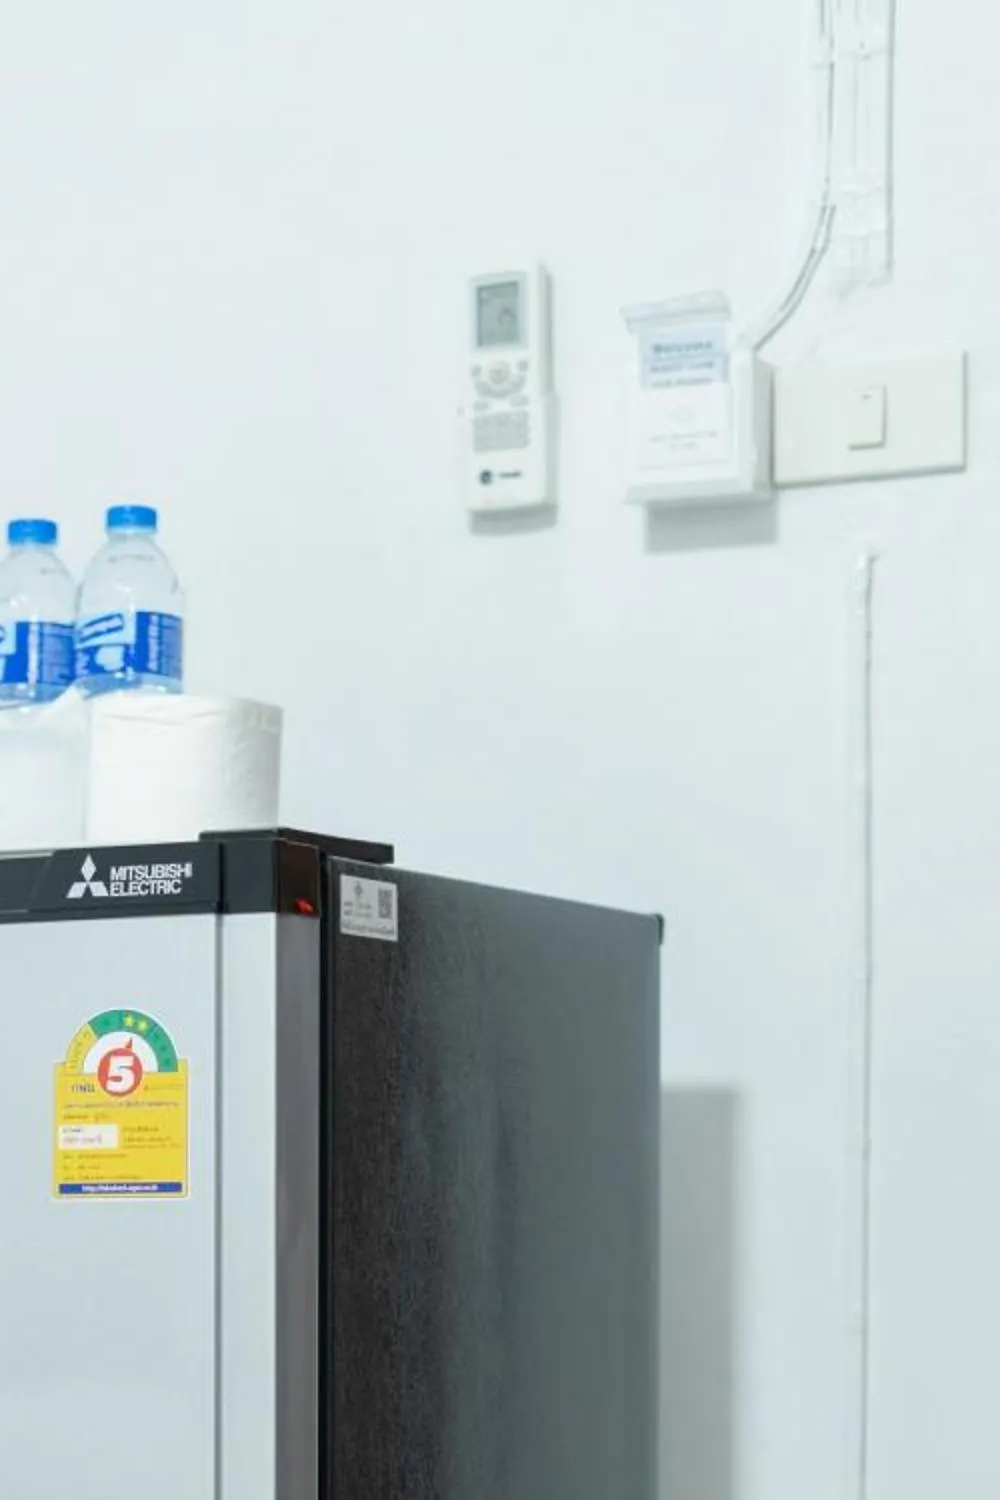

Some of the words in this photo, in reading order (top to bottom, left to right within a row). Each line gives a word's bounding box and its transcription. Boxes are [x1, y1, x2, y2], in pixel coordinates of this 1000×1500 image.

[110, 862, 193, 881] MITSUBISHI
[109, 879, 182, 896] ELECTRIC
[105, 1055, 135, 1094] 5
